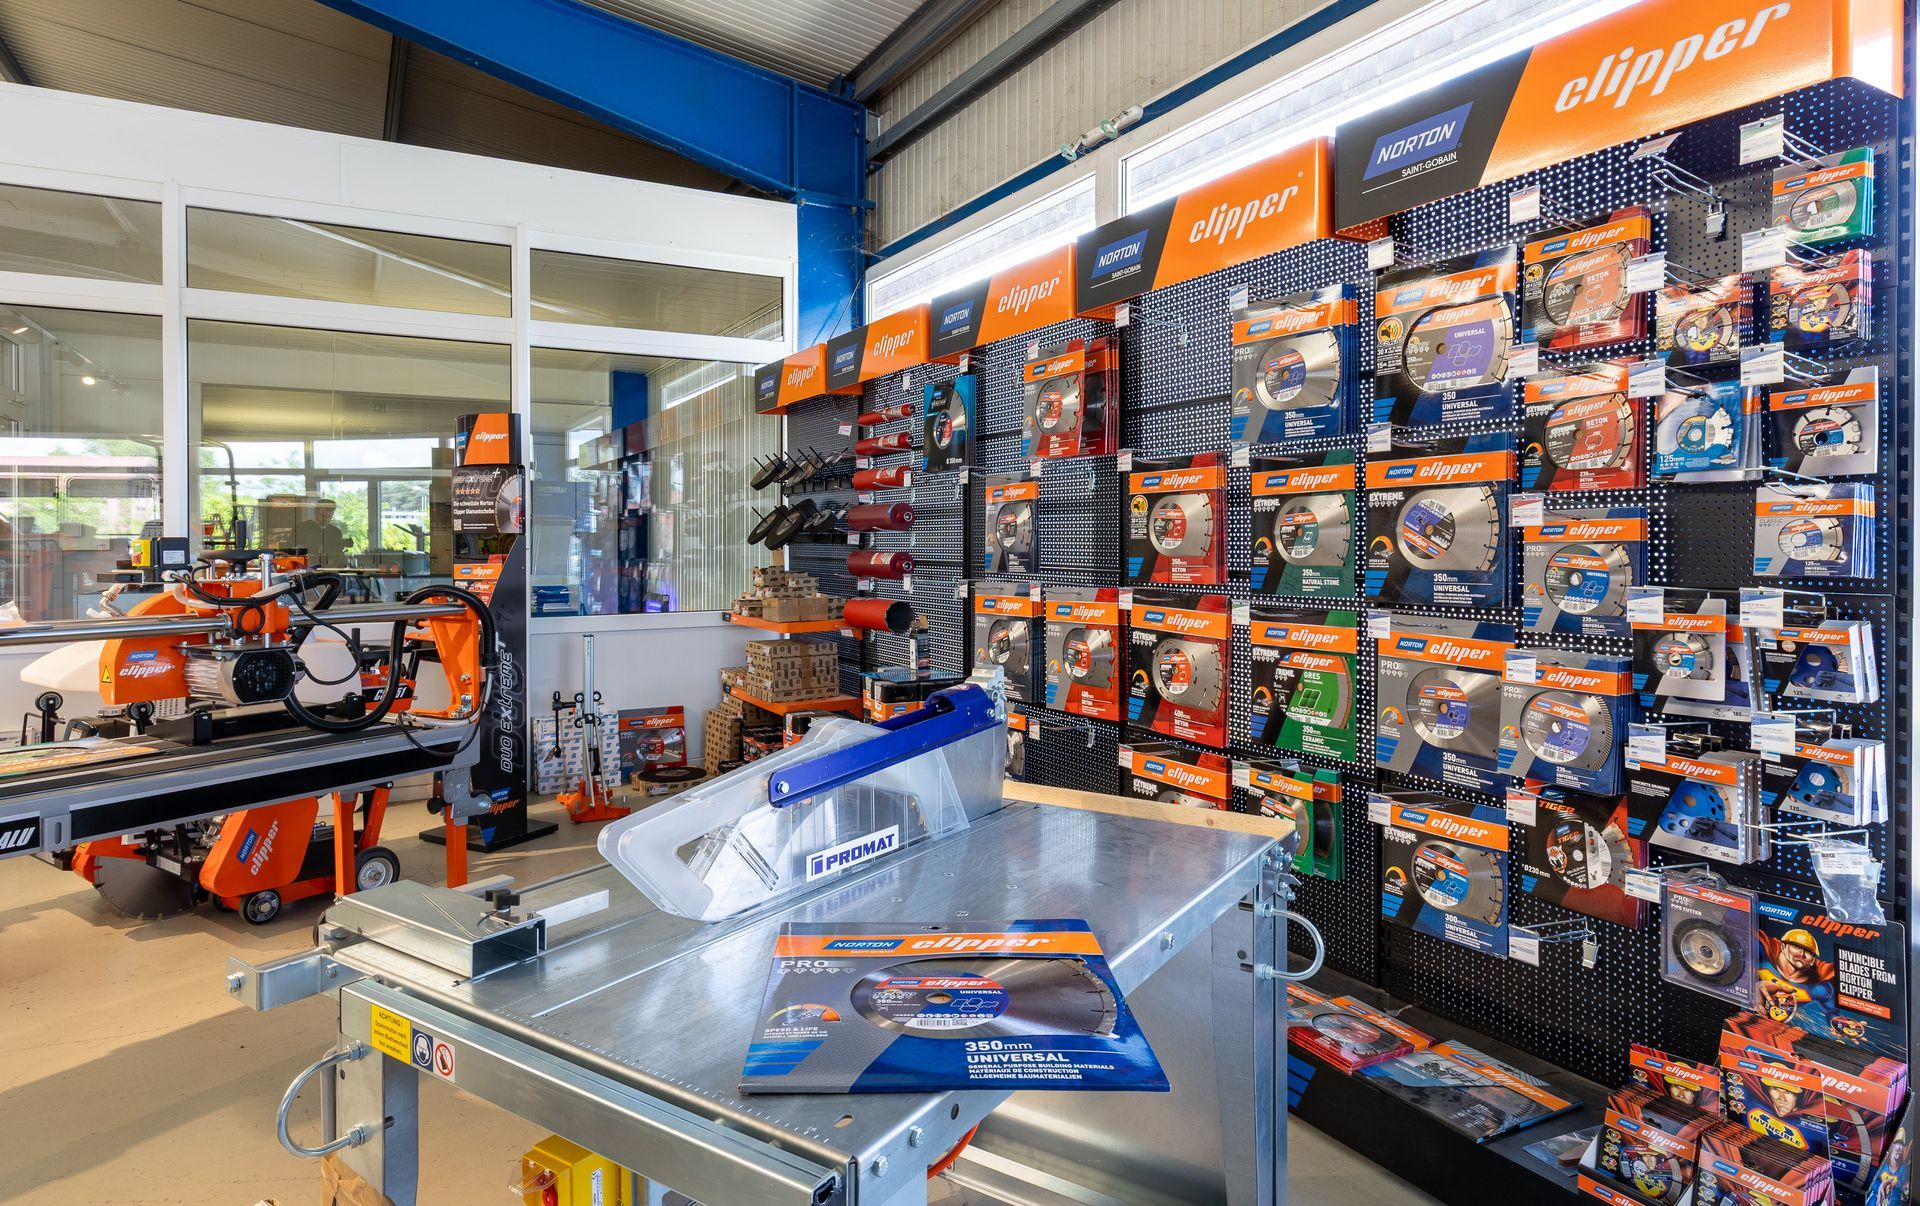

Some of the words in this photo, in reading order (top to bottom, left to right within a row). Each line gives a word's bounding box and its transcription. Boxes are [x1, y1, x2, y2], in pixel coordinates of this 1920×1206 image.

[1554, 2, 1792, 113] clipper
[1377, 120, 1457, 164] NORTON
[1402, 152, 1457, 178] SAINT-GOBAIN
[1809, 168, 1855, 183] clipper
[1189, 185, 1299, 245] clipper
[1544, 242, 1566, 251] NORTON
[1571, 227, 1625, 248] clipper
[1099, 242, 1140, 269] NORTON
[1568, 254, 1609, 273] clipper
[1112, 264, 1142, 279] SAINT-GOBAIN
[1587, 270, 1610, 283] BETON
[1430, 276, 1493, 298] clipper
[998, 276, 1060, 316] clipper
[943, 308, 970, 326] NORTON
[1250, 324, 1271, 333] NORTON
[1275, 311, 1324, 332] clipper
[1435, 308, 1479, 322] clipper
[1455, 328, 1486, 338] UNIVERSAL
[874, 330, 915, 359] clipper
[1235, 347, 1250, 355] PRO
[836, 350, 855, 364] NORTON
[1048, 359, 1074, 373] clipper
[788, 365, 816, 389] clipper
[1442, 393, 1456, 401] 350
[1811, 389, 1862, 402] clipper
[1442, 401, 1478, 411] UNIVERSAL
[1568, 401, 1604, 416] clipper
[1285, 411, 1305, 419] 350mm
[1586, 417, 1608, 427] BETON
[1285, 419, 1314, 428] UNIVERSAL
[475, 432, 507, 442] clipper
[1660, 455, 1685, 463] 125mm
[1388, 468, 1413, 476] NORTON
[1419, 461, 1483, 480] clipper
[1164, 474, 1202, 489] clipper
[1291, 473, 1338, 489] clipper
[1005, 488, 1027, 499] clipper
[1369, 492, 1404, 502] EXTREME
[1254, 499, 1280, 507] EXTREME
[1796, 503, 1843, 514] clipper
[1569, 524, 1623, 539] clipper
[1571, 558, 1602, 567] clipper
[473, 565, 494, 577] clipper
[1302, 569, 1320, 577] 350mm
[1434, 574, 1458, 583] 350mm
[1434, 585, 1470, 593] UNIVERSAL
[997, 600, 1023, 613] clipper
[1074, 606, 1105, 620] clipper
[1167, 614, 1210, 631] clipper
[1668, 617, 1712, 629] clipper
[1291, 629, 1339, 646] clipper
[1802, 632, 1845, 641] clipper
[1253, 648, 1280, 658] EXTREME
[1429, 642, 1492, 662] clipper
[1293, 655, 1334, 668] clipper
[1381, 660, 1399, 670] PRO
[120, 664, 171, 679] clipper
[1304, 671, 1321, 680] GRES
[1547, 672, 1601, 688] clipper
[1438, 689, 1464, 698] clipper
[1553, 706, 1585, 719] clipper
[647, 717, 675, 726] clipper
[1175, 719, 1189, 728] BETON
[1567, 722, 1589, 731] UNIVERSAL
[1303, 726, 1321, 735] 350mm
[1303, 735, 1325, 745] CERAMIC
[501, 736, 512, 773] DUO
[1443, 752, 1467, 764] 350mm
[1805, 748, 1849, 760] clipper
[1146, 762, 1164, 772] NORTON
[1167, 767, 1210, 786] clipper
[1443, 763, 1478, 778] UNIVERSAL
[1671, 762, 1721, 777] clipper
[1556, 773, 1580, 781] UNIVERSAL
[1133, 778, 1158, 793] EXTREME
[1273, 778, 1305, 793] clipper
[491, 800, 518, 816] lipper
[1539, 800, 1576, 814] TIGER
[1403, 812, 1426, 822] NORTON
[1431, 818, 1488, 838] clipper
[0, 827, 36, 849] ALU
[1385, 827, 1417, 842] EXTREME
[1558, 831, 1580, 844] TIGER
[240, 833, 256, 861] NORTON
[250, 819, 279, 877] clipper
[826, 834, 895, 871] PROMAT
[1437, 857, 1465, 872] clipper
[1701, 891, 1734, 904] clipper
[1683, 907, 1702, 916] CUTTER
[1760, 905, 1793, 918] NORTON
[1445, 913, 1468, 927] 300mm
[1445, 923, 1478, 938] UNIVERSAL
[1801, 914, 1881, 941] clipper
[911, 936, 1052, 952] clipper
[780, 960, 829, 968] PRO
[1838, 949, 1885, 970] INVINCIBLE
[1839, 962, 1870, 977] BLADES
[1872, 970, 1897, 986] FROM
[1839, 973, 1873, 988] NORTON
[926, 980, 989, 988] clipper
[1840, 983, 1876, 1002] CLIPPER.
[965, 1041, 1033, 1052] 350mm
[967, 1053, 1070, 1063] UNIVERSAL
[1666, 1066, 1703, 1081] clipper
[1762, 1066, 1803, 1083] clipper
[1619, 1119, 1639, 1130] NORTON
[1641, 1127, 1687, 1151] clipper
[1750, 1115, 1801, 1146] INVINCIBLE
[1715, 1162, 1737, 1173] NORTON
[1740, 1173, 1793, 1198] clipper
